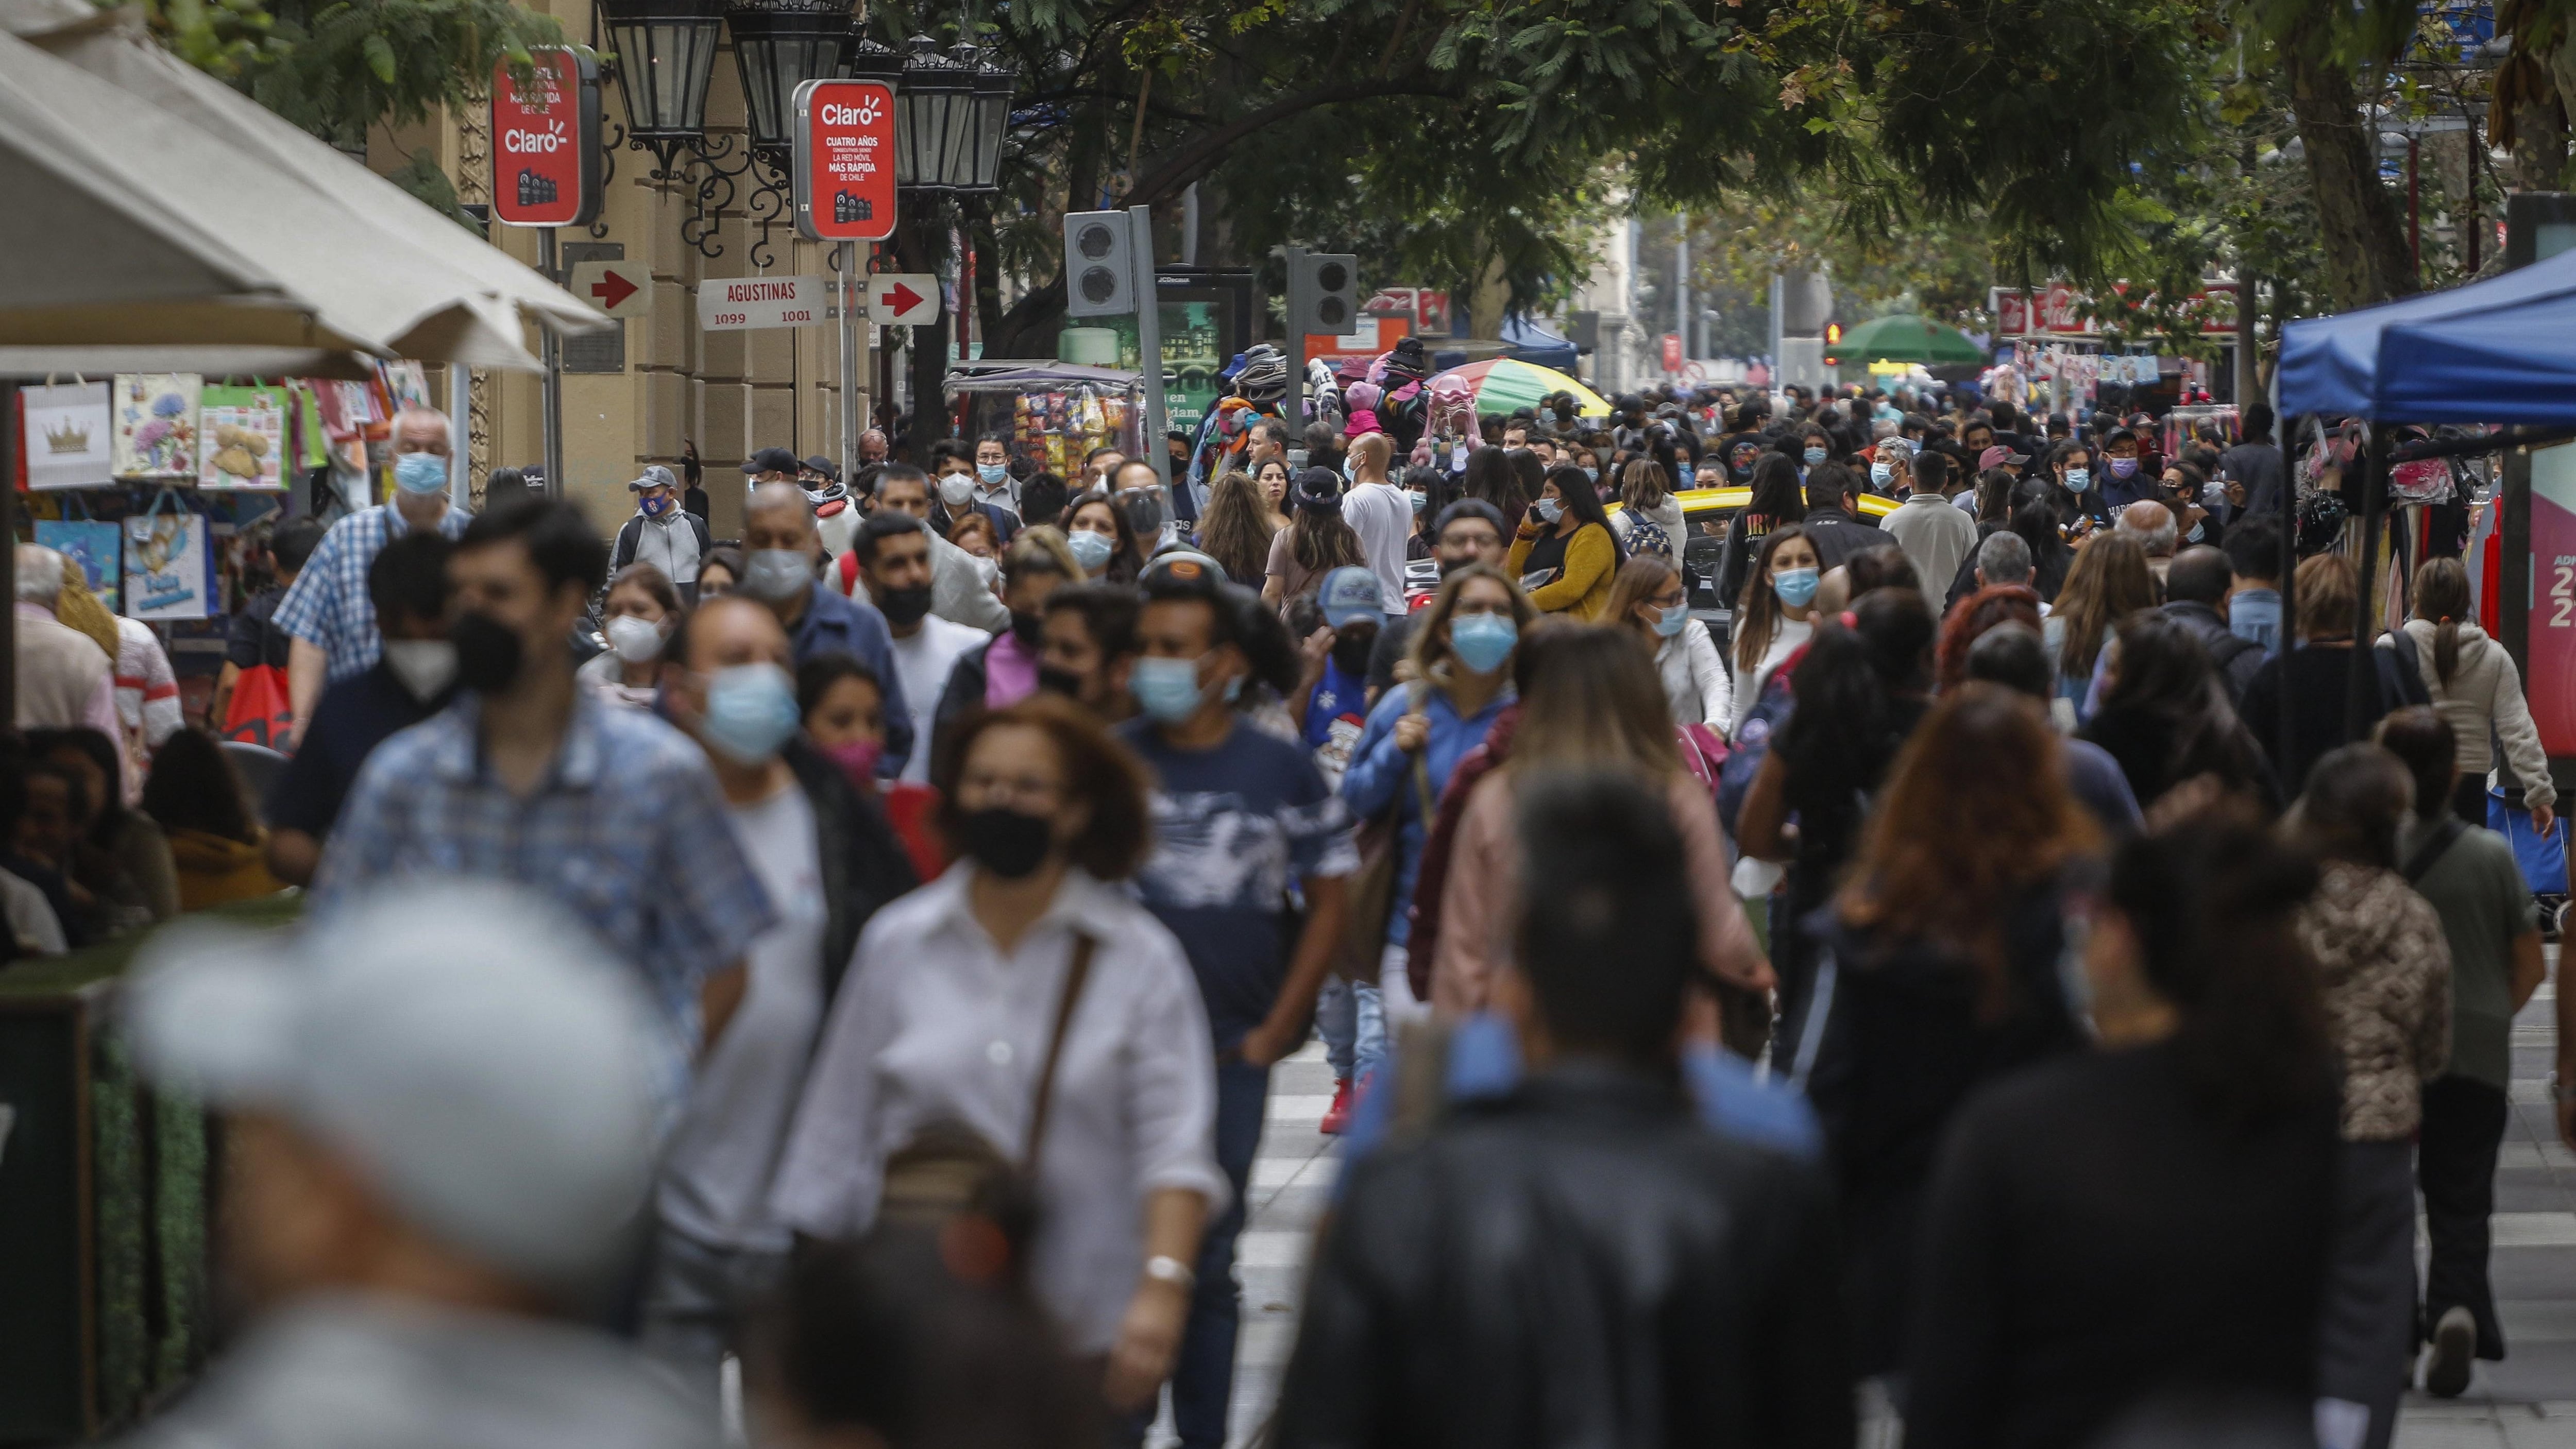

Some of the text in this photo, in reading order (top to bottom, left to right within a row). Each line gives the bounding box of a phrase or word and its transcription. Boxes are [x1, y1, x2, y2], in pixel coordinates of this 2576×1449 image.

[821, 104, 873, 126] Claro
[505, 128, 557, 153] Claro
[826, 135, 878, 147] CUATRO AÑOS
[854, 152, 871, 162] MÓVIL
[829, 161, 876, 173] MÁS RÁPIDA
[727, 282, 795, 302] AGUSTINAS
[715, 310, 811, 325] 1099 1001
[1170, 406, 1202, 419] dam,
[1174, 519, 1191, 531] as
[2550, 567, 2576, 595] 2
[2549, 597, 2576, 627] 2
